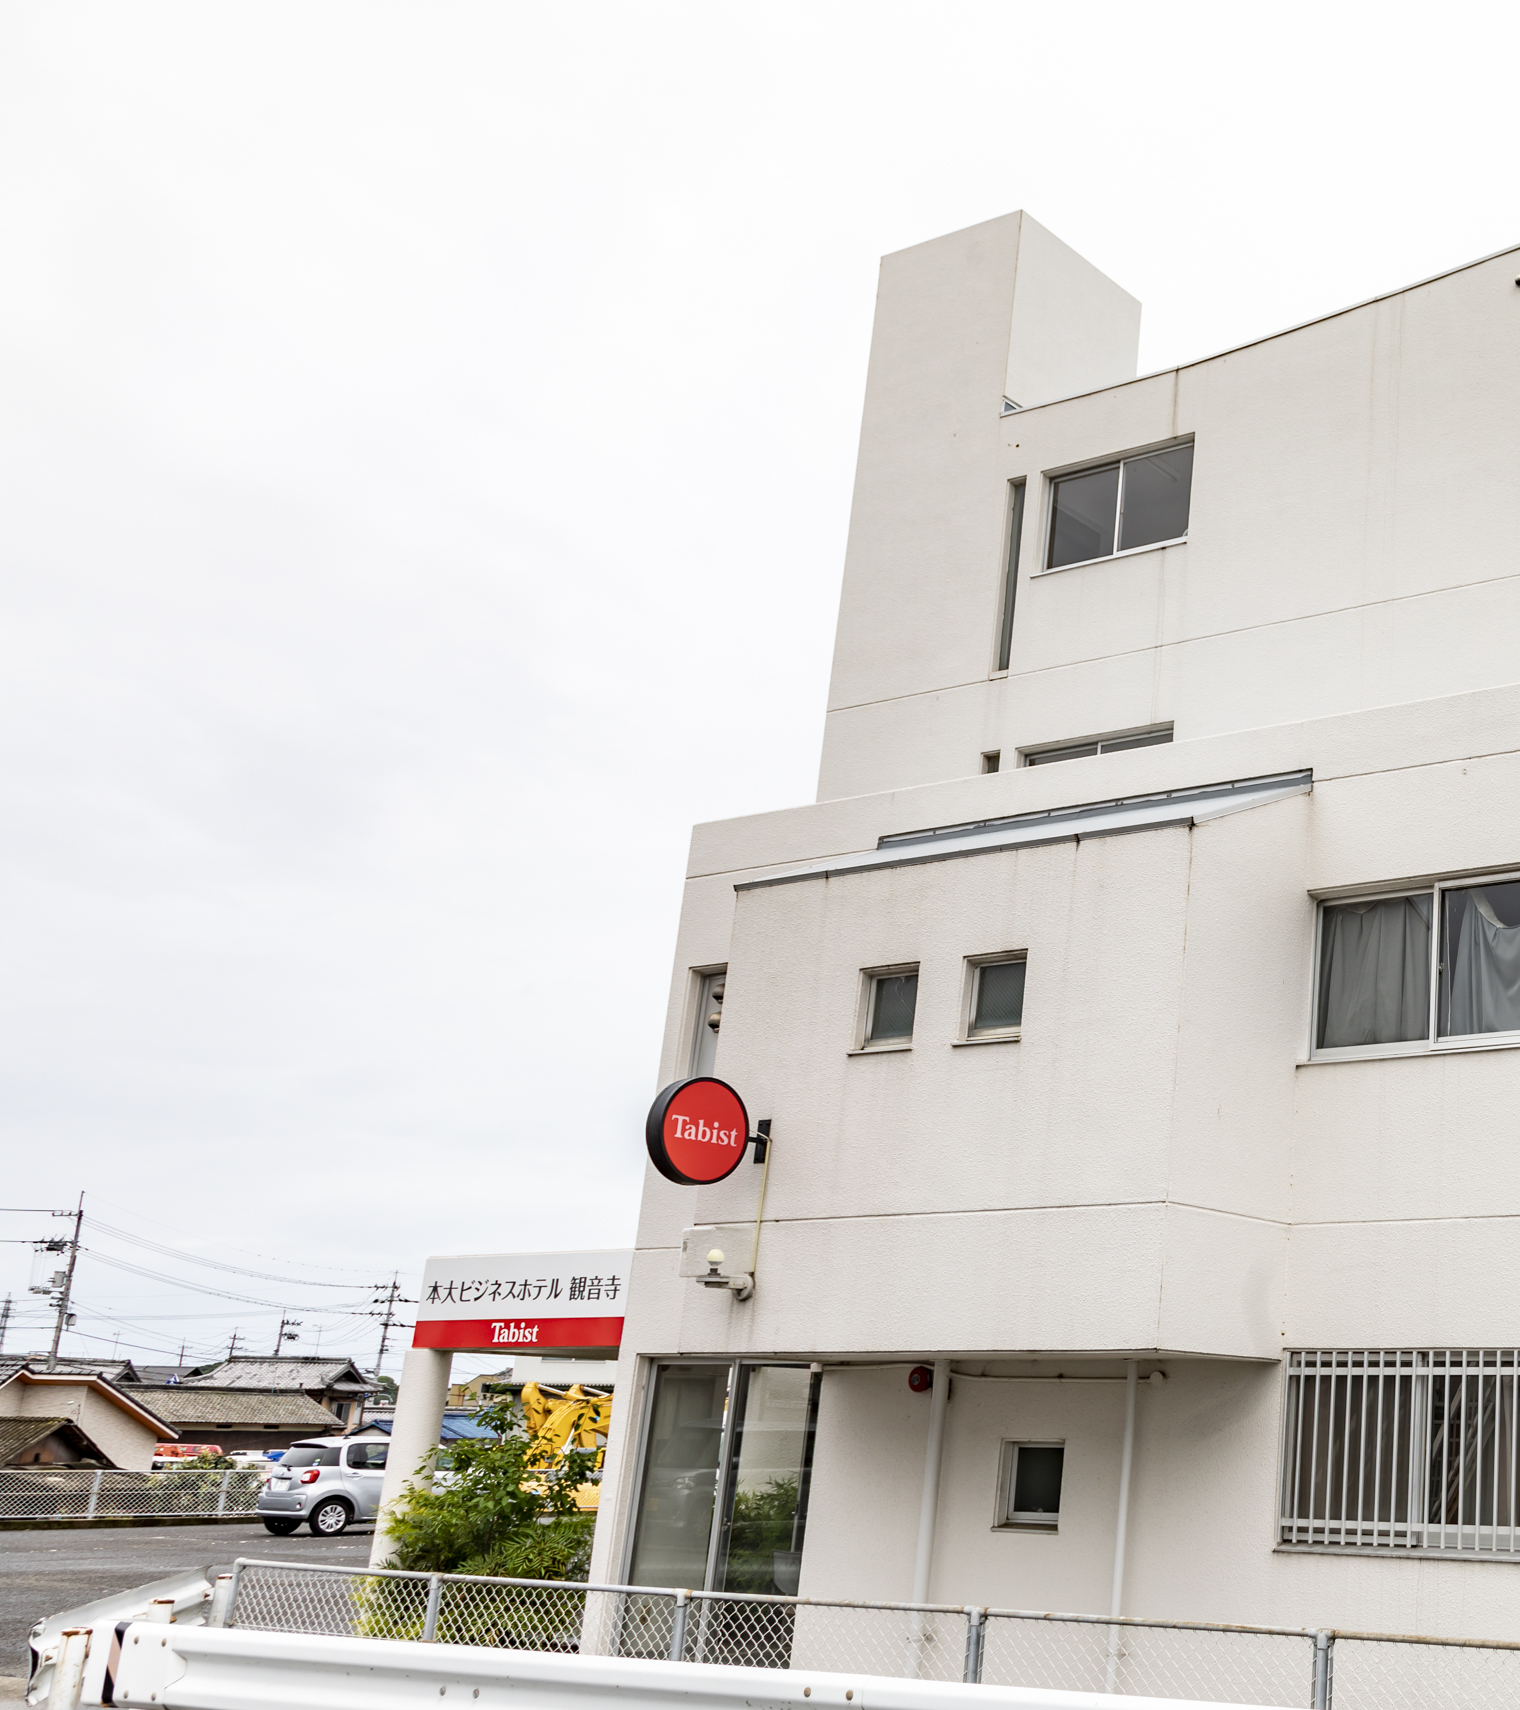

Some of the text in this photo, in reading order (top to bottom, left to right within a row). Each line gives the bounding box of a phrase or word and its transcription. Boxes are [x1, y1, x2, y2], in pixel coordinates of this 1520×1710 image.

[671, 1114, 738, 1147] Tabist
[426, 1275, 622, 1304] 本大ビジネスホテル 観音寺
[491, 1321, 539, 1343] Tabist
